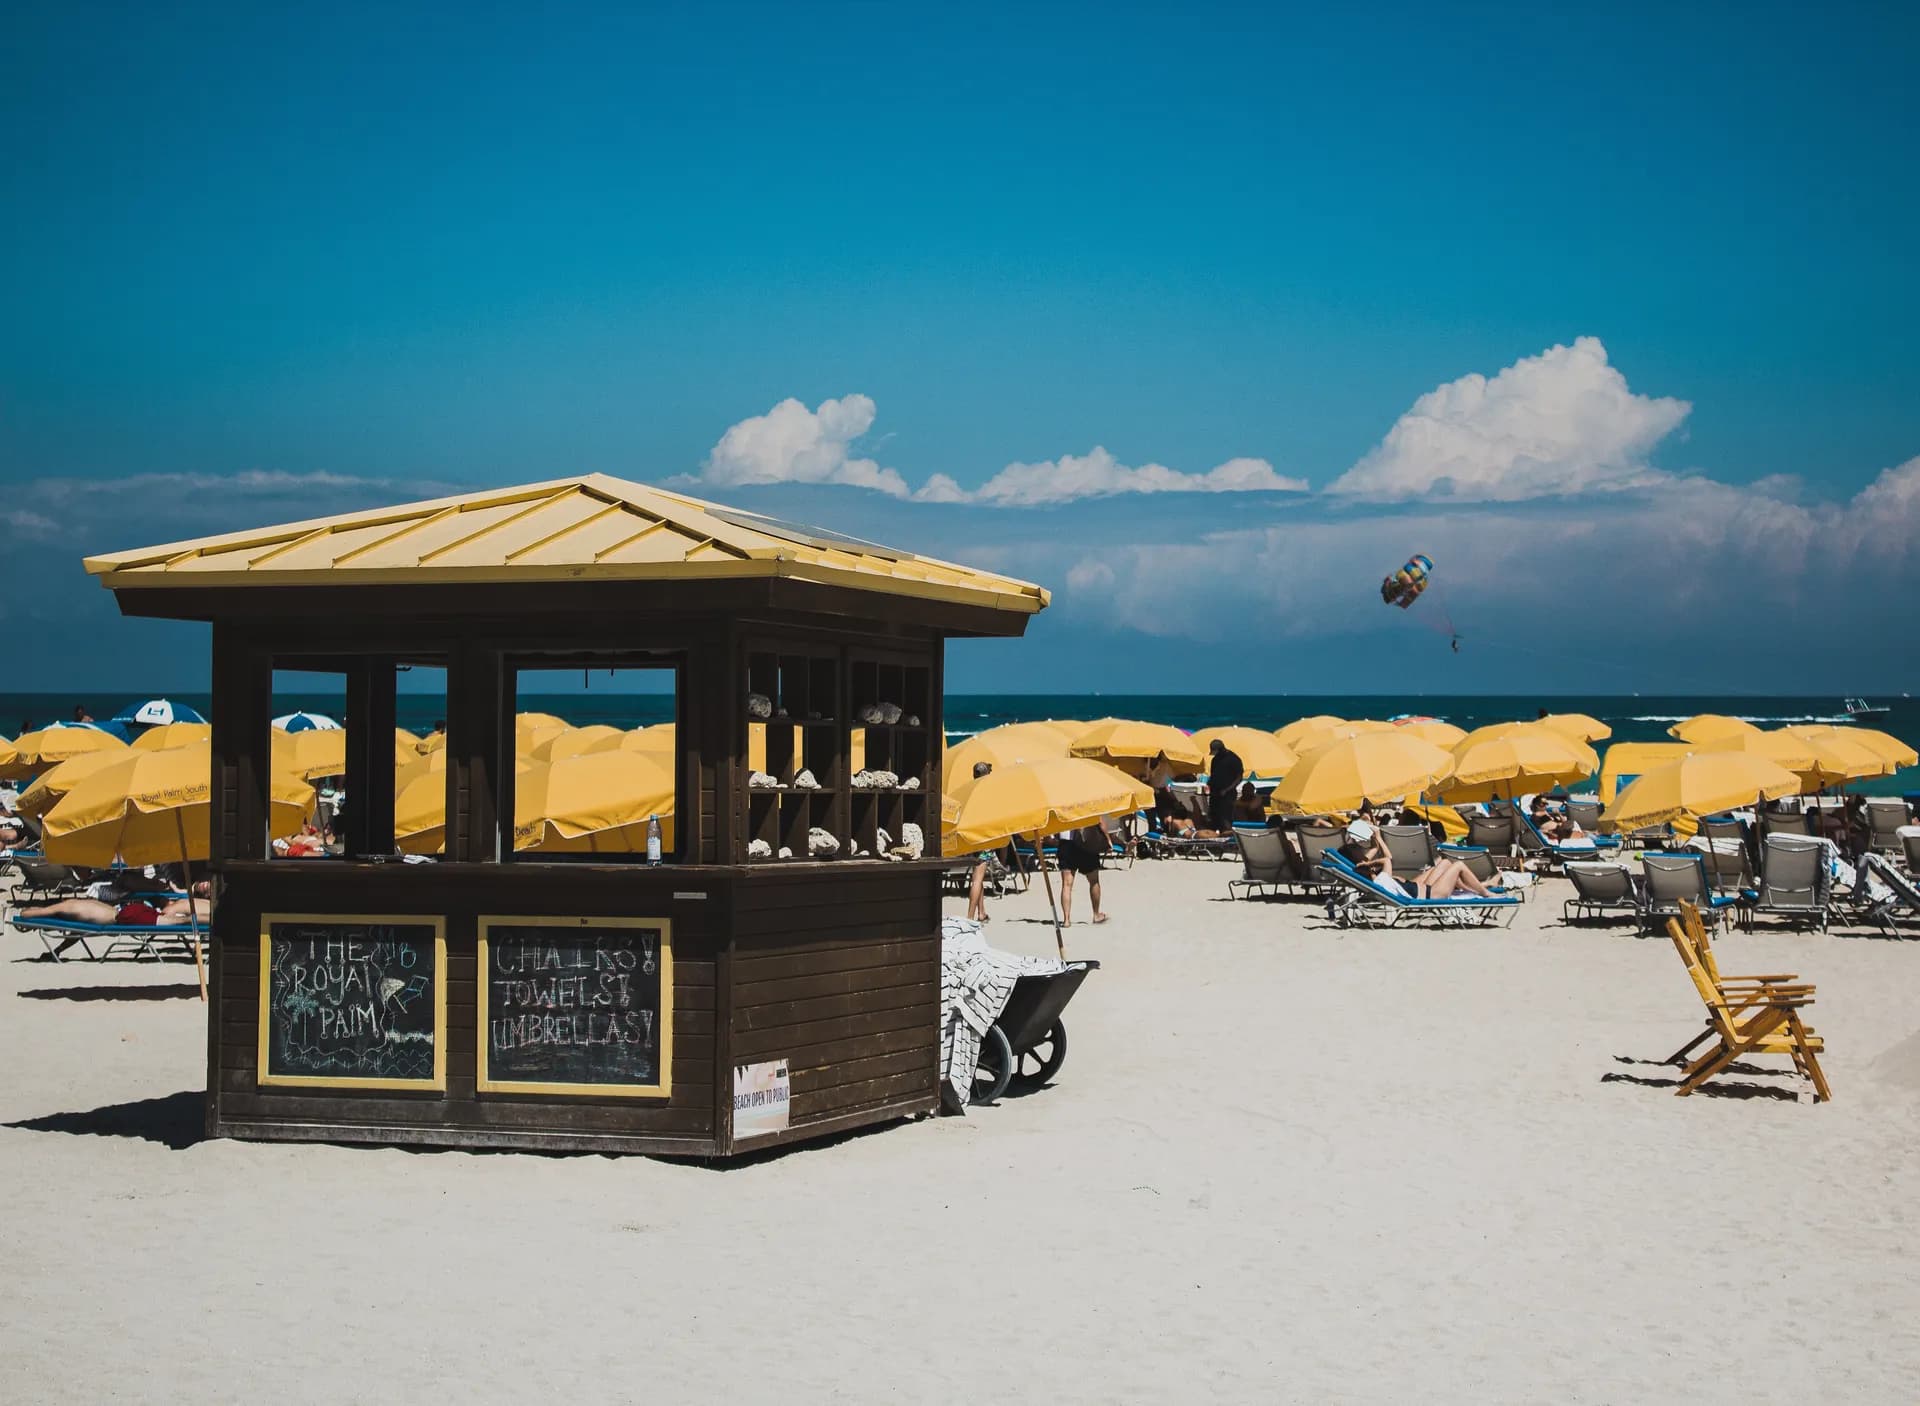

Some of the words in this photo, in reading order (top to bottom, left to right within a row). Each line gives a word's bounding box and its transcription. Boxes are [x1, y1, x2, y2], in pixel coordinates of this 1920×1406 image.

[141, 791, 161, 804] Royal
[184, 782, 208, 795] South
[298, 931, 371, 963] THE
[734, 1094, 751, 1110] BEACH
[752, 1090, 764, 1107] OPEN
[766, 1088, 773, 1104] TO
